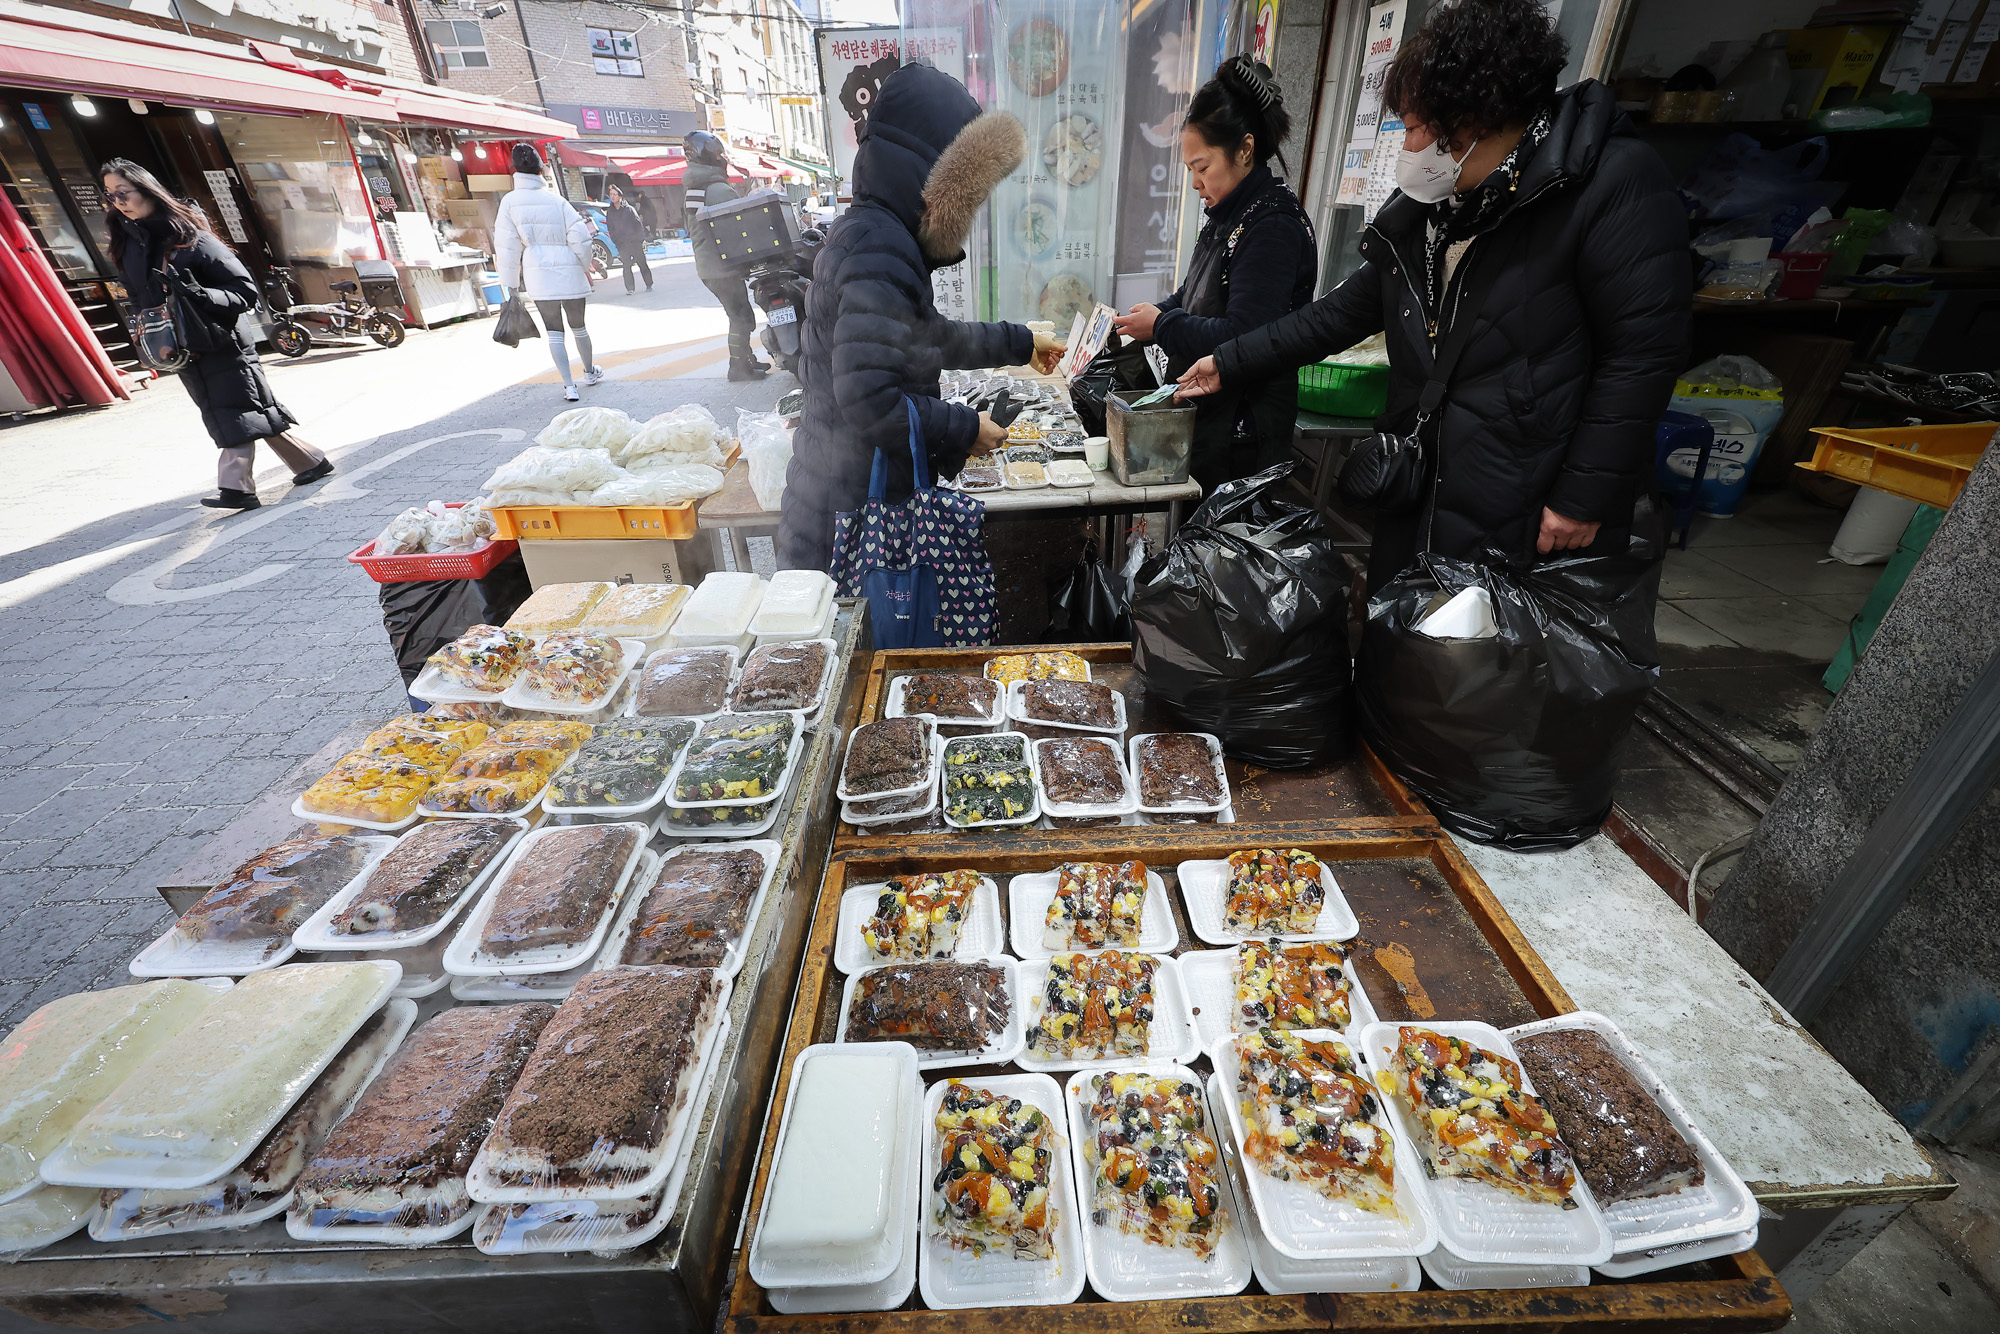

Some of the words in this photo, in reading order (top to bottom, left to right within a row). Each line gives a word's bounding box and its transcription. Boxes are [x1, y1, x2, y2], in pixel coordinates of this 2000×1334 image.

[832, 40, 869, 60] 자연담은
[871, 38, 899, 59] 해풍에
[1371, 37, 1393, 56] 5000원
[1842, 49, 1875, 62] Maxim
[605, 110, 671, 129] 바다한스푼
[1356, 110, 1378, 128] 5,000원
[775, 312, 794, 324] 2578
[662, 563, 671, 574] ISO
[664, 574, 673, 584] 90
